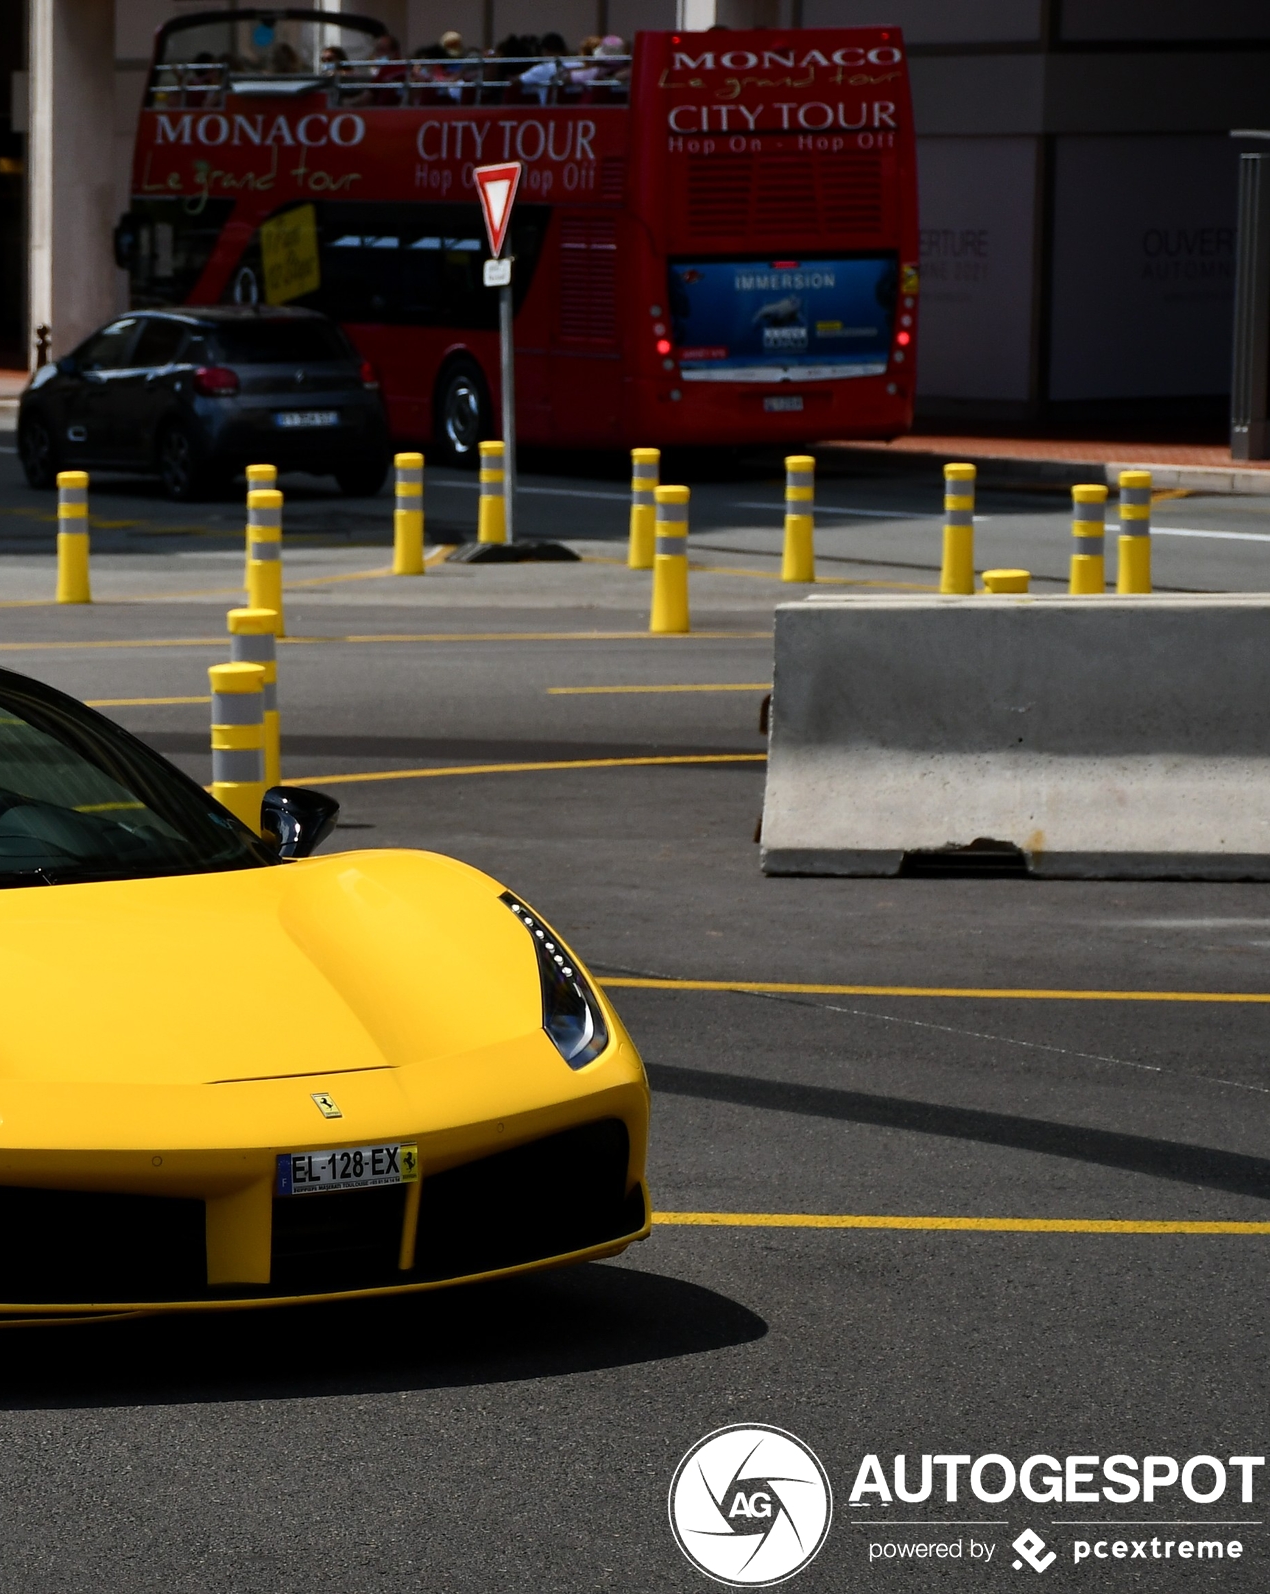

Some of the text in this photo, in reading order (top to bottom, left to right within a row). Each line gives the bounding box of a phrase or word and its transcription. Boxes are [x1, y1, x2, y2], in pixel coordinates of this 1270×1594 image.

[672, 46, 902, 71] MONACO
[657, 64, 902, 100] Le grand tour
[154, 113, 366, 147] MONACO
[668, 100, 898, 134] CITY TOUR
[416, 119, 596, 162] CITY TOUR
[668, 135, 715, 157] Hop
[729, 134, 762, 154] On
[798, 133, 844, 153] Hop
[857, 131, 895, 150] Off
[142, 143, 363, 216] Le grand tour
[415, 163, 452, 197] Hop
[563, 161, 596, 190] Off
[919, 229, 988, 257] ERTURE
[1142, 227, 1237, 257] OUVER
[734, 272, 835, 291] IMMERSION
[1141, 260, 1232, 281] AUTOMN
[282, 1178, 287, 1188] F
